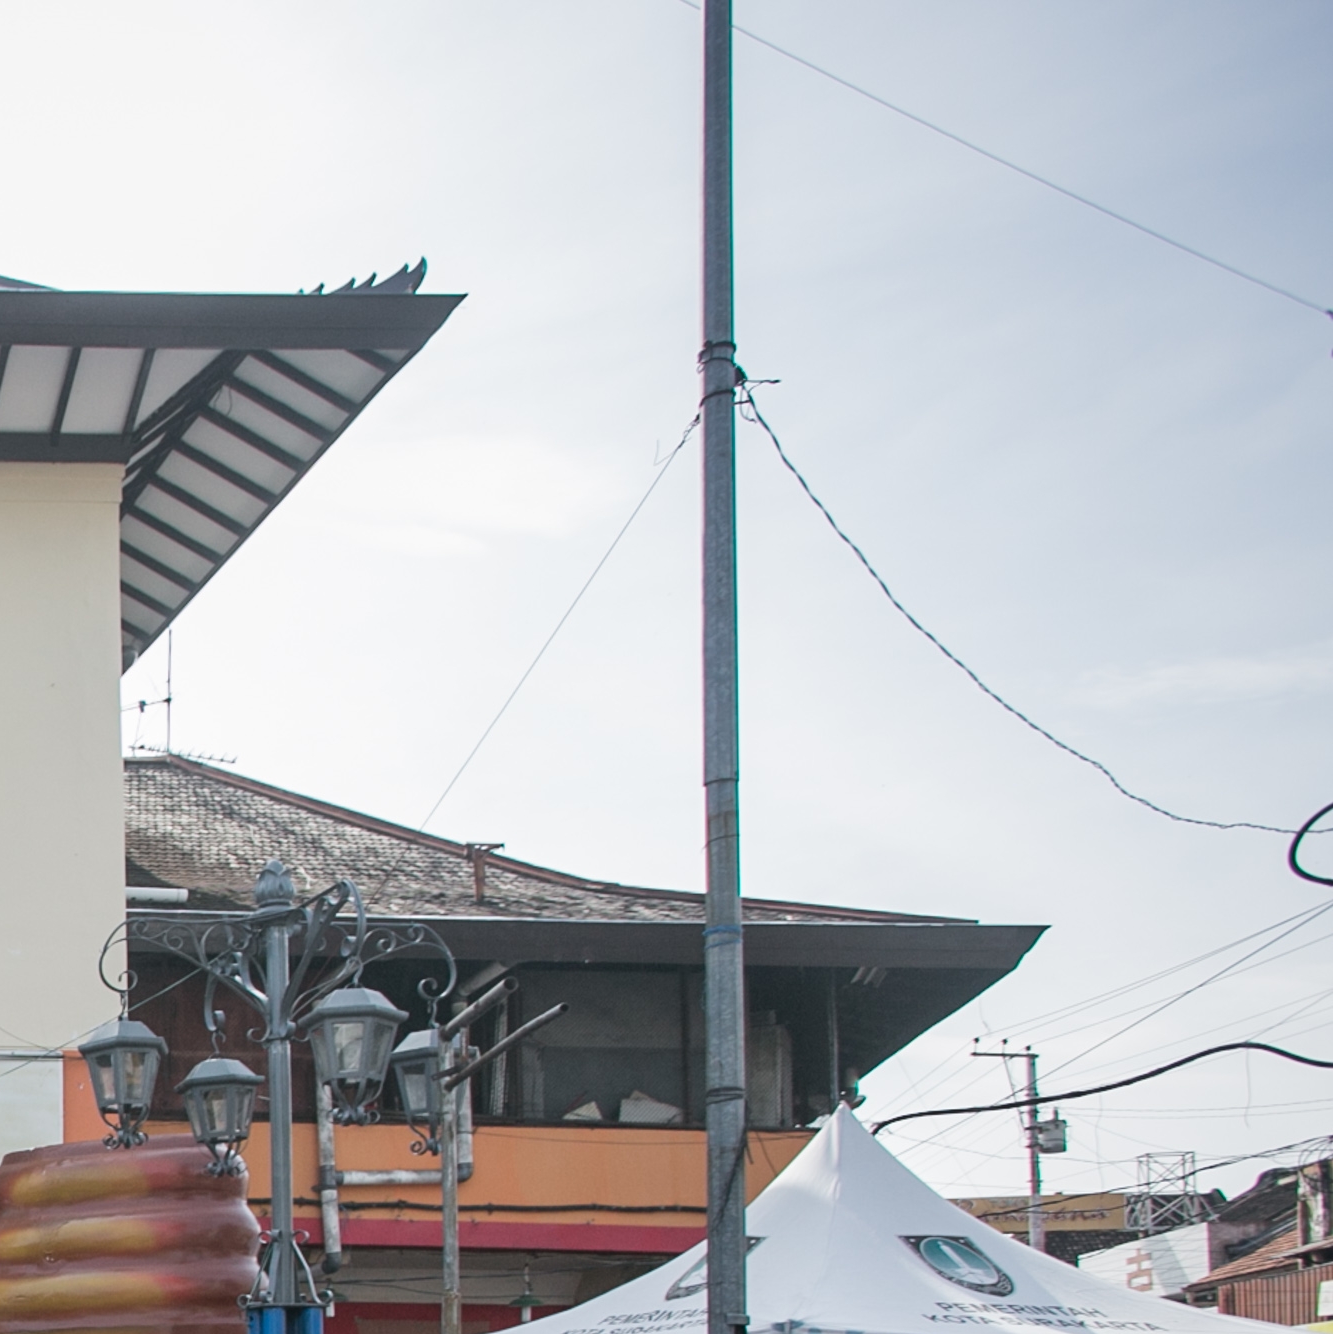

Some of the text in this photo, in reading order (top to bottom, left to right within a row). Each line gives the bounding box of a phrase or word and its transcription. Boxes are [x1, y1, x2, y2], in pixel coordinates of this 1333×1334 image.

[935, 1302, 1107, 1319] PEMERINTAH
[921, 1313, 1167, 1333] KOTA SURAKARTA
